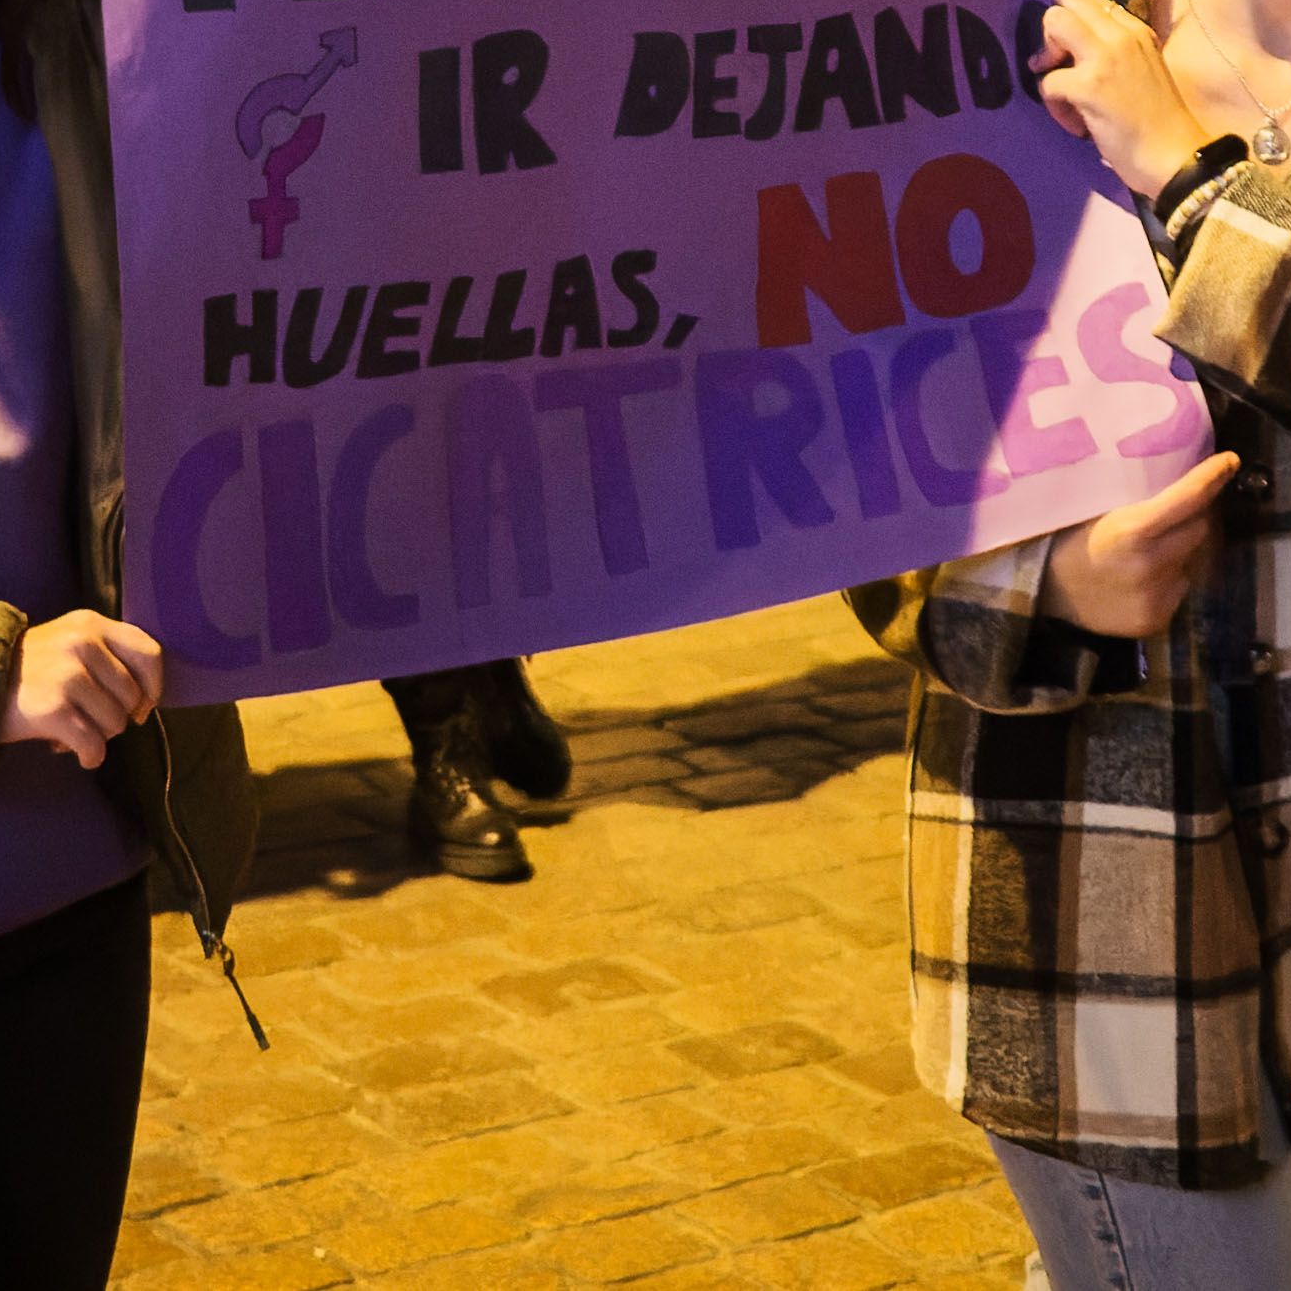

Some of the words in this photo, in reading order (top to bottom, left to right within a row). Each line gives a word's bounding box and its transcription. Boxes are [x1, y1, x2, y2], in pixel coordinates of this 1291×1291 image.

[418, 29, 558, 175] IR
[203, 250, 701, 390] HUELLAS,
[755, 152, 1036, 348] NO
[151, 280, 1216, 673] CICATRICES
